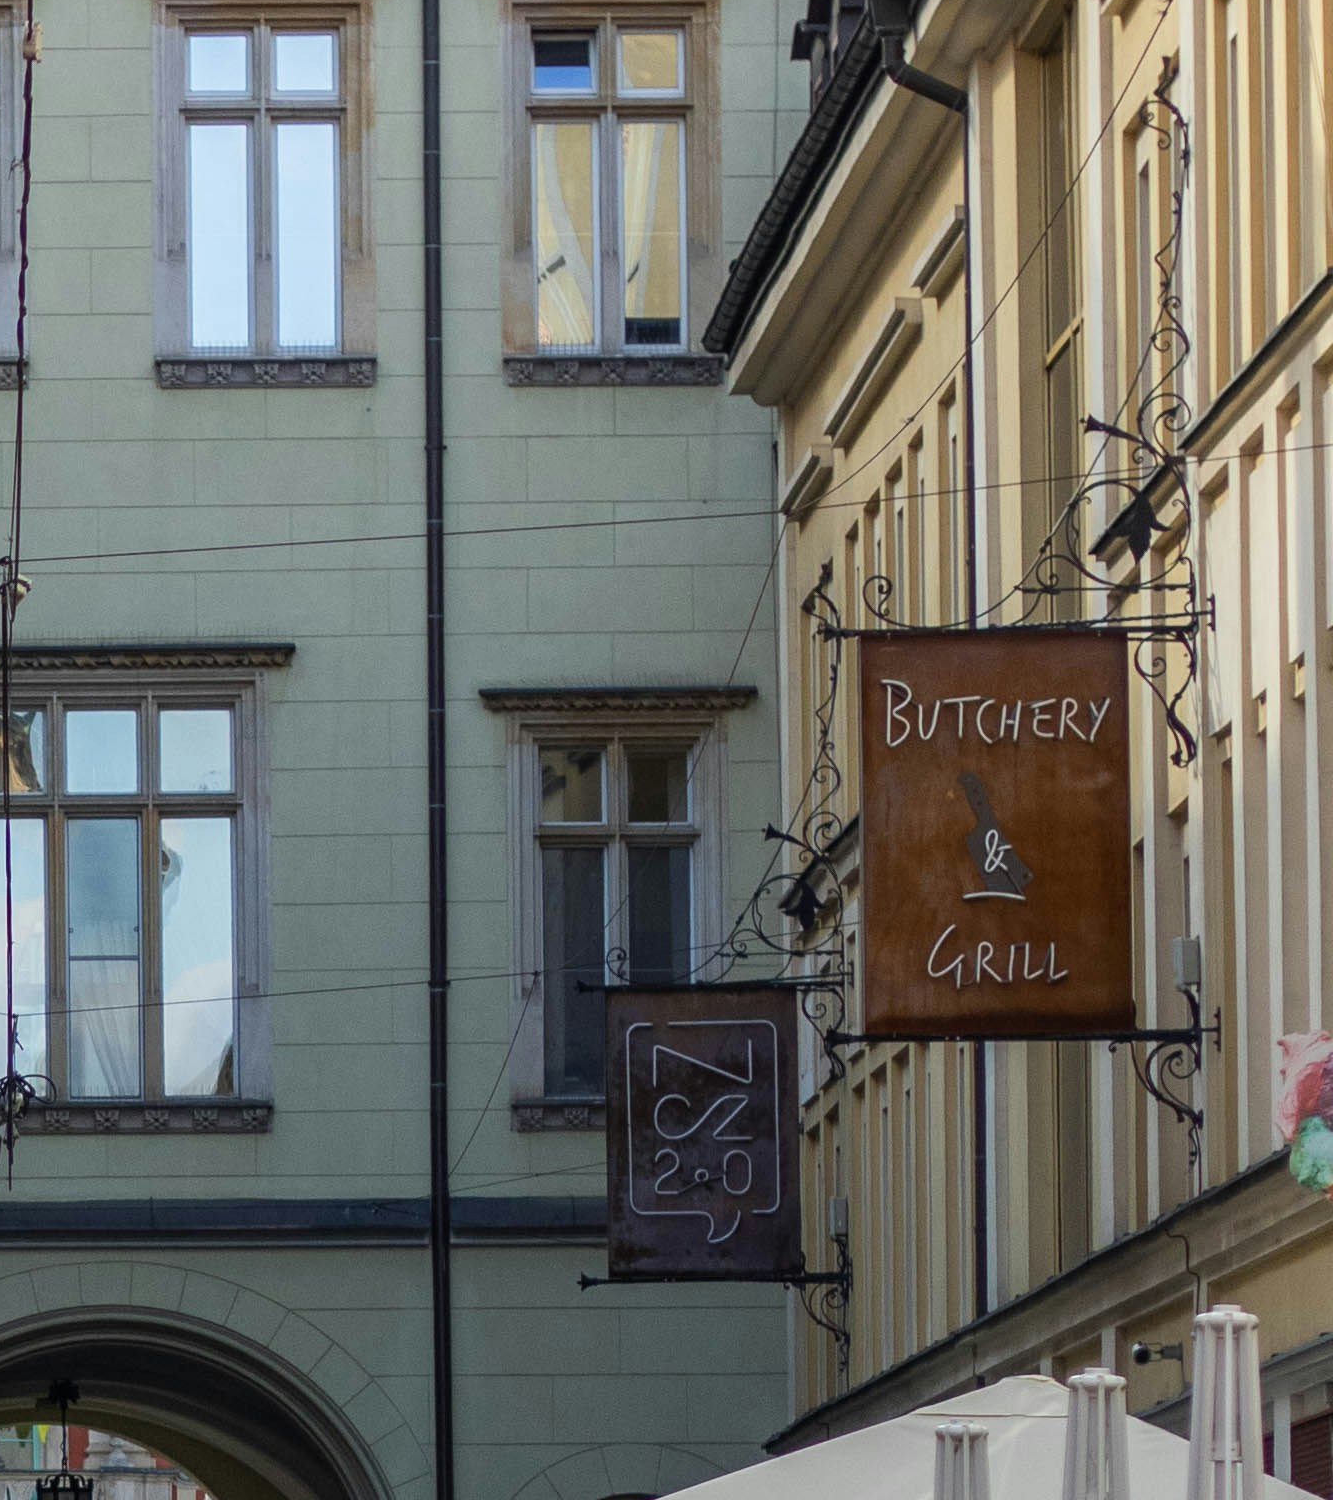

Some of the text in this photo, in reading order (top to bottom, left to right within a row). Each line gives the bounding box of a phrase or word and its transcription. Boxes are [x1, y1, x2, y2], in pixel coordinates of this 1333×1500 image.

[881, 678, 1111, 748] BUTCHERY
[984, 828, 1013, 874] &
[927, 923, 1069, 990] GRILL
